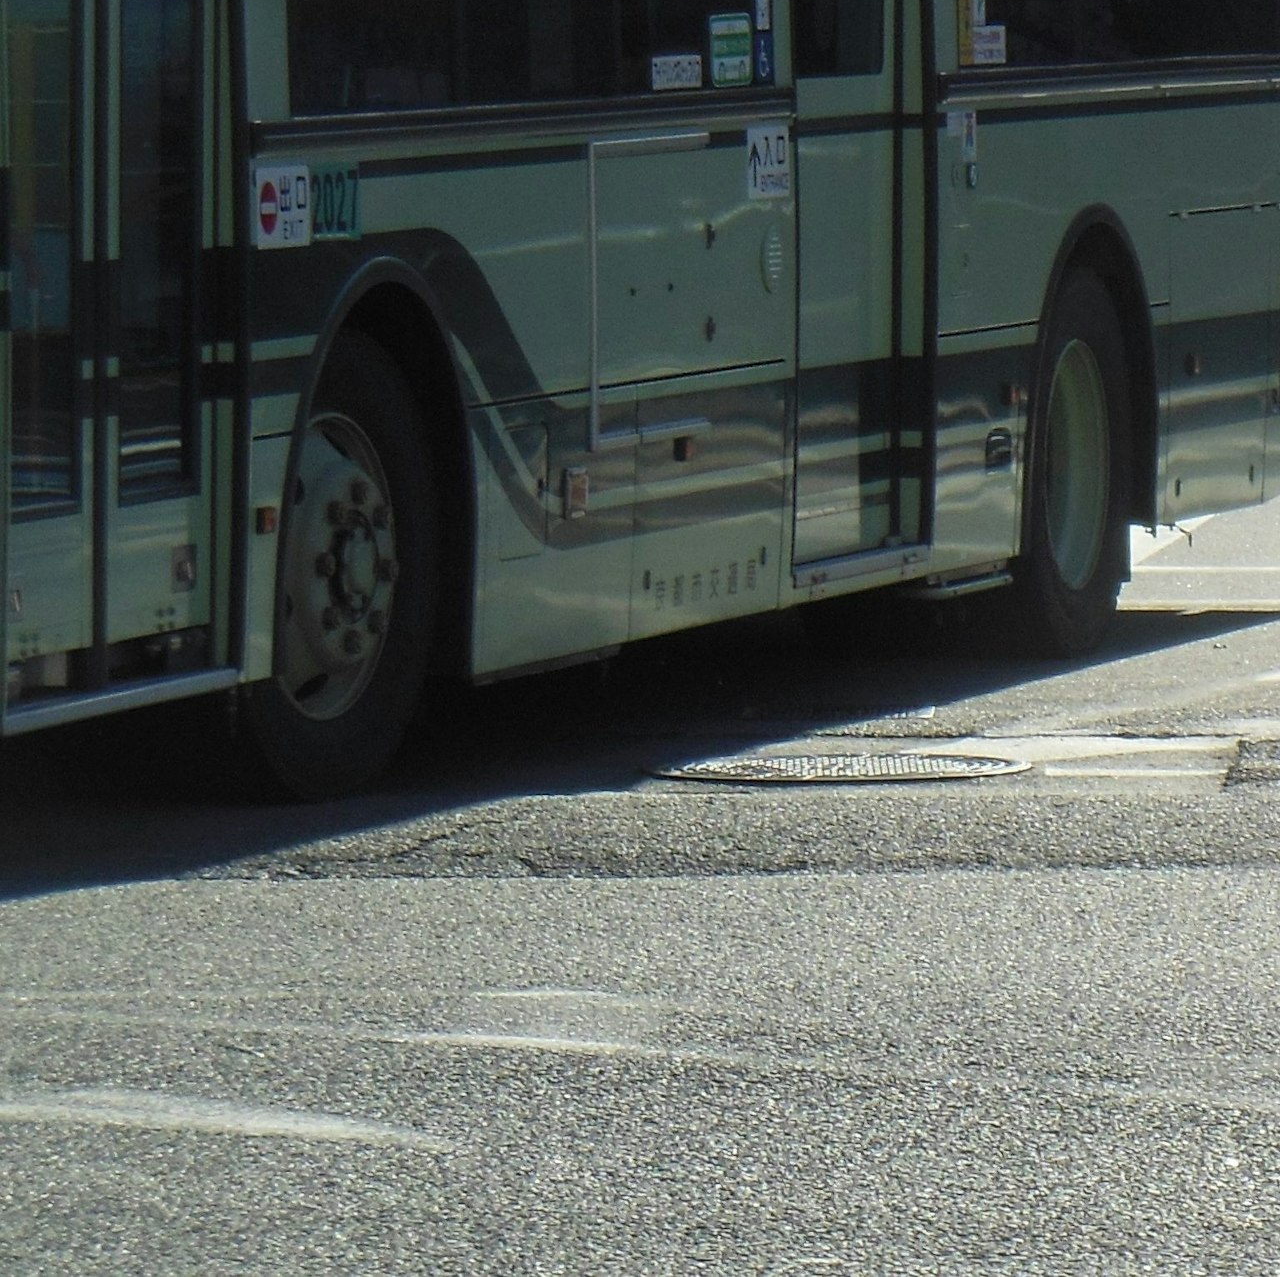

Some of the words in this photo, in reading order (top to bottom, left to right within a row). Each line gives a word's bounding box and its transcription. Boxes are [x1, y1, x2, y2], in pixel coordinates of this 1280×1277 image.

[763, 135, 785, 166] 入口
[279, 175, 307, 212] 出口
[312, 171, 358, 234] 2027
